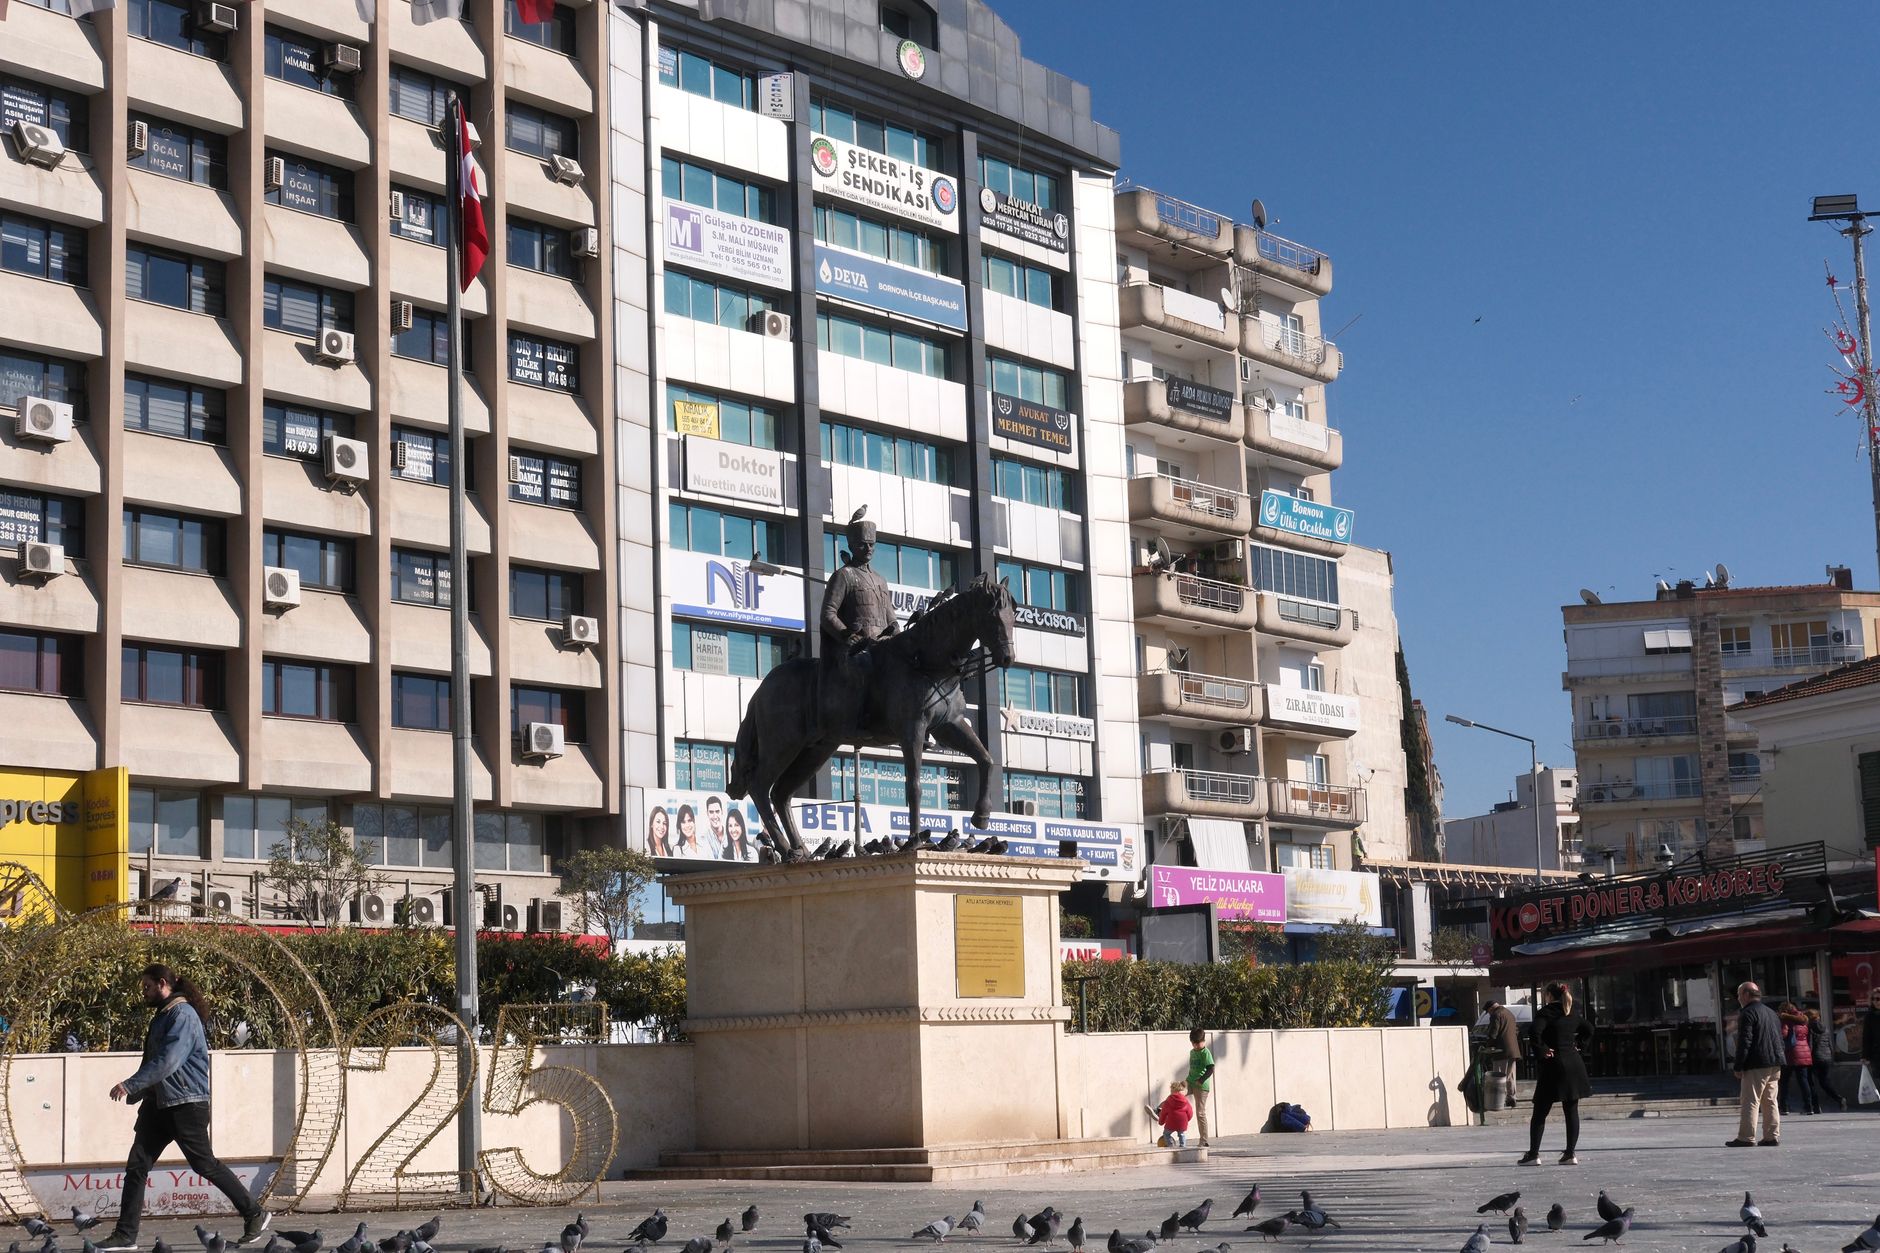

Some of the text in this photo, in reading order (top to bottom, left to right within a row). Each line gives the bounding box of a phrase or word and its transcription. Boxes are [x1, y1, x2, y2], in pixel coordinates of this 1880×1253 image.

[842, 170, 930, 211] SENDİKASI
[1007, 195, 1042, 216] AVUKAT
[704, 214, 784, 243] Gülşah ÖZDEMİR
[1029, 213, 1054, 230] TURAN
[728, 234, 746, 247] MALİ
[833, 266, 869, 289] DEVA
[878, 282, 909, 297] BORNOVA
[922, 294, 959, 311] BAŞKANLIĞI
[515, 368, 543, 381] KAPTAN
[1018, 405, 1050, 422] AVUKAT
[997, 417, 1070, 447] MEHMET TEMEL
[718, 451, 775, 477] Doktor
[693, 474, 777, 499] Nurettin AKGÜN
[706, 609, 772, 624] www.nifyapi.com
[696, 642, 723, 656] HARİTA
[1319, 702, 1345, 718] ODASI
[802, 803, 872, 833] BETA
[1050, 826, 1072, 838] HASTA
[1073, 828, 1095, 839] KABUL
[1095, 829, 1119, 840] KURSU
[1094, 850, 1116, 860] KLAVYE
[1190, 875, 1217, 892] YELİZ
[1219, 879, 1264, 894] DALKARA
[1571, 884, 1645, 922] DÖNER
[1646, 882, 1664, 910] &
[1666, 862, 1785, 907] KOKOREÇ
[172, 1191, 209, 1201] Bornova
